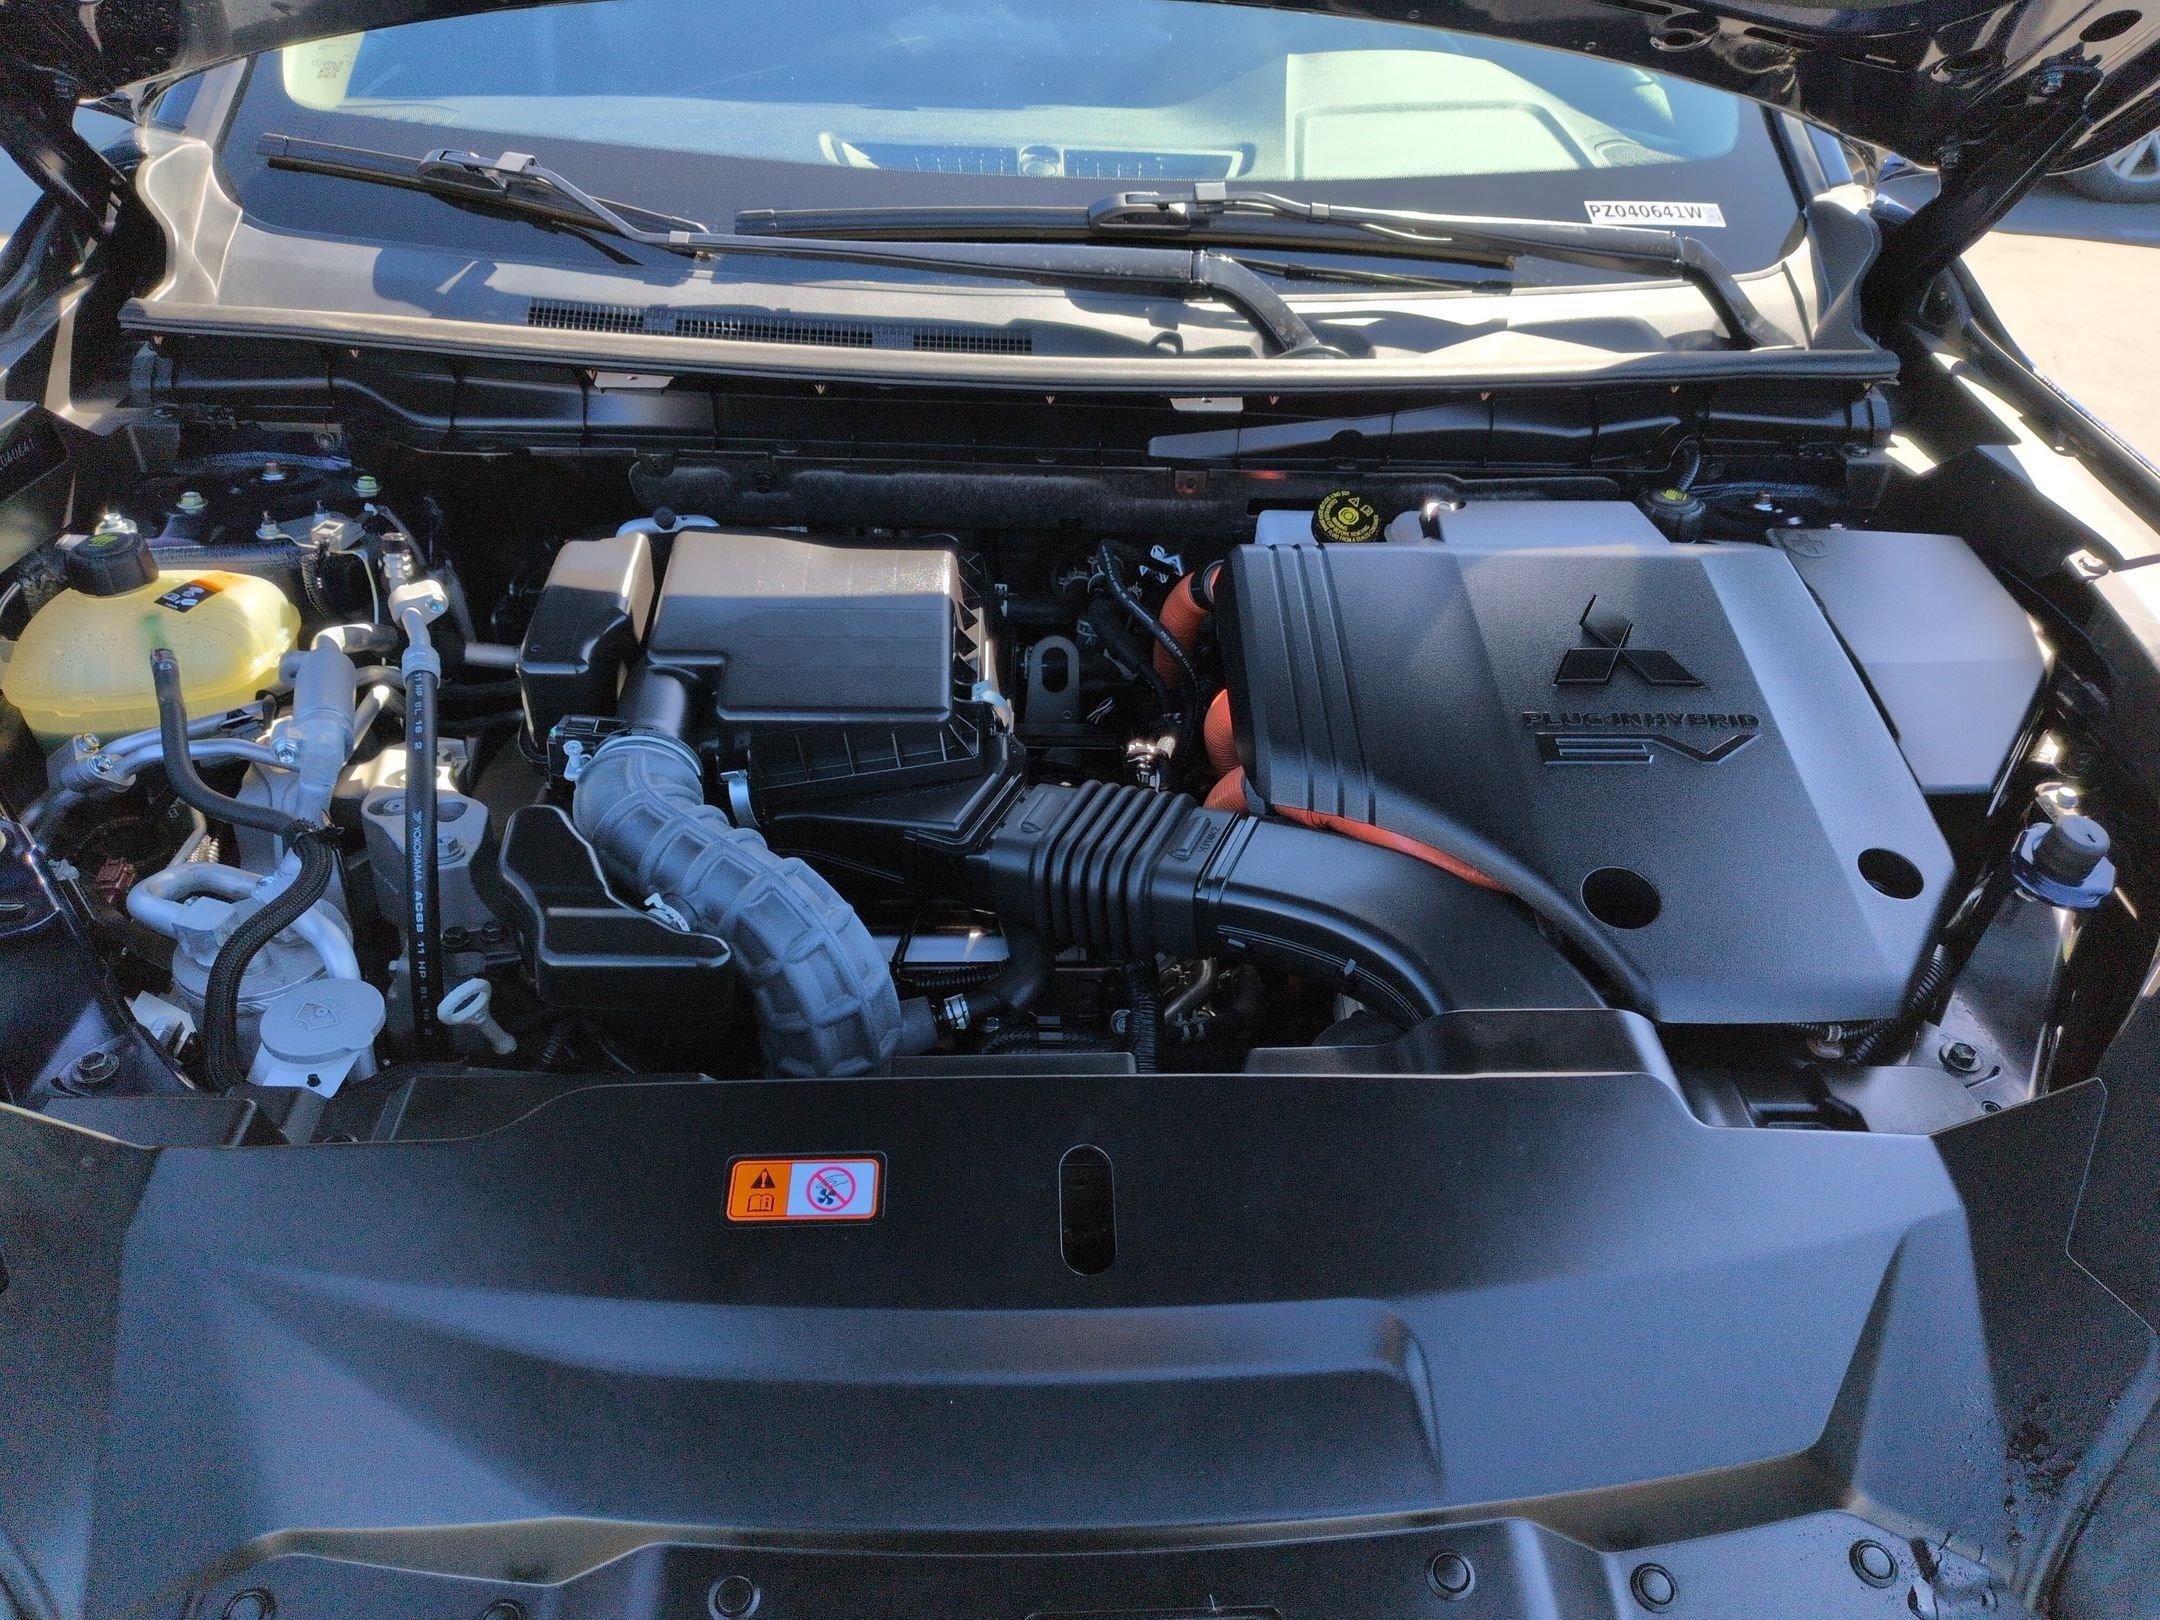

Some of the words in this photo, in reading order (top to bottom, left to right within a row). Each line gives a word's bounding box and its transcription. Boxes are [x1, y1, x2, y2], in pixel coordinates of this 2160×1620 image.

[1588, 204, 1703, 219] PZ040641W
[1649, 712, 1761, 728] HYBRID
[413, 825, 422, 882] YOKOHAMA
[417, 941, 425, 955] 11
[418, 961, 427, 978] HP
